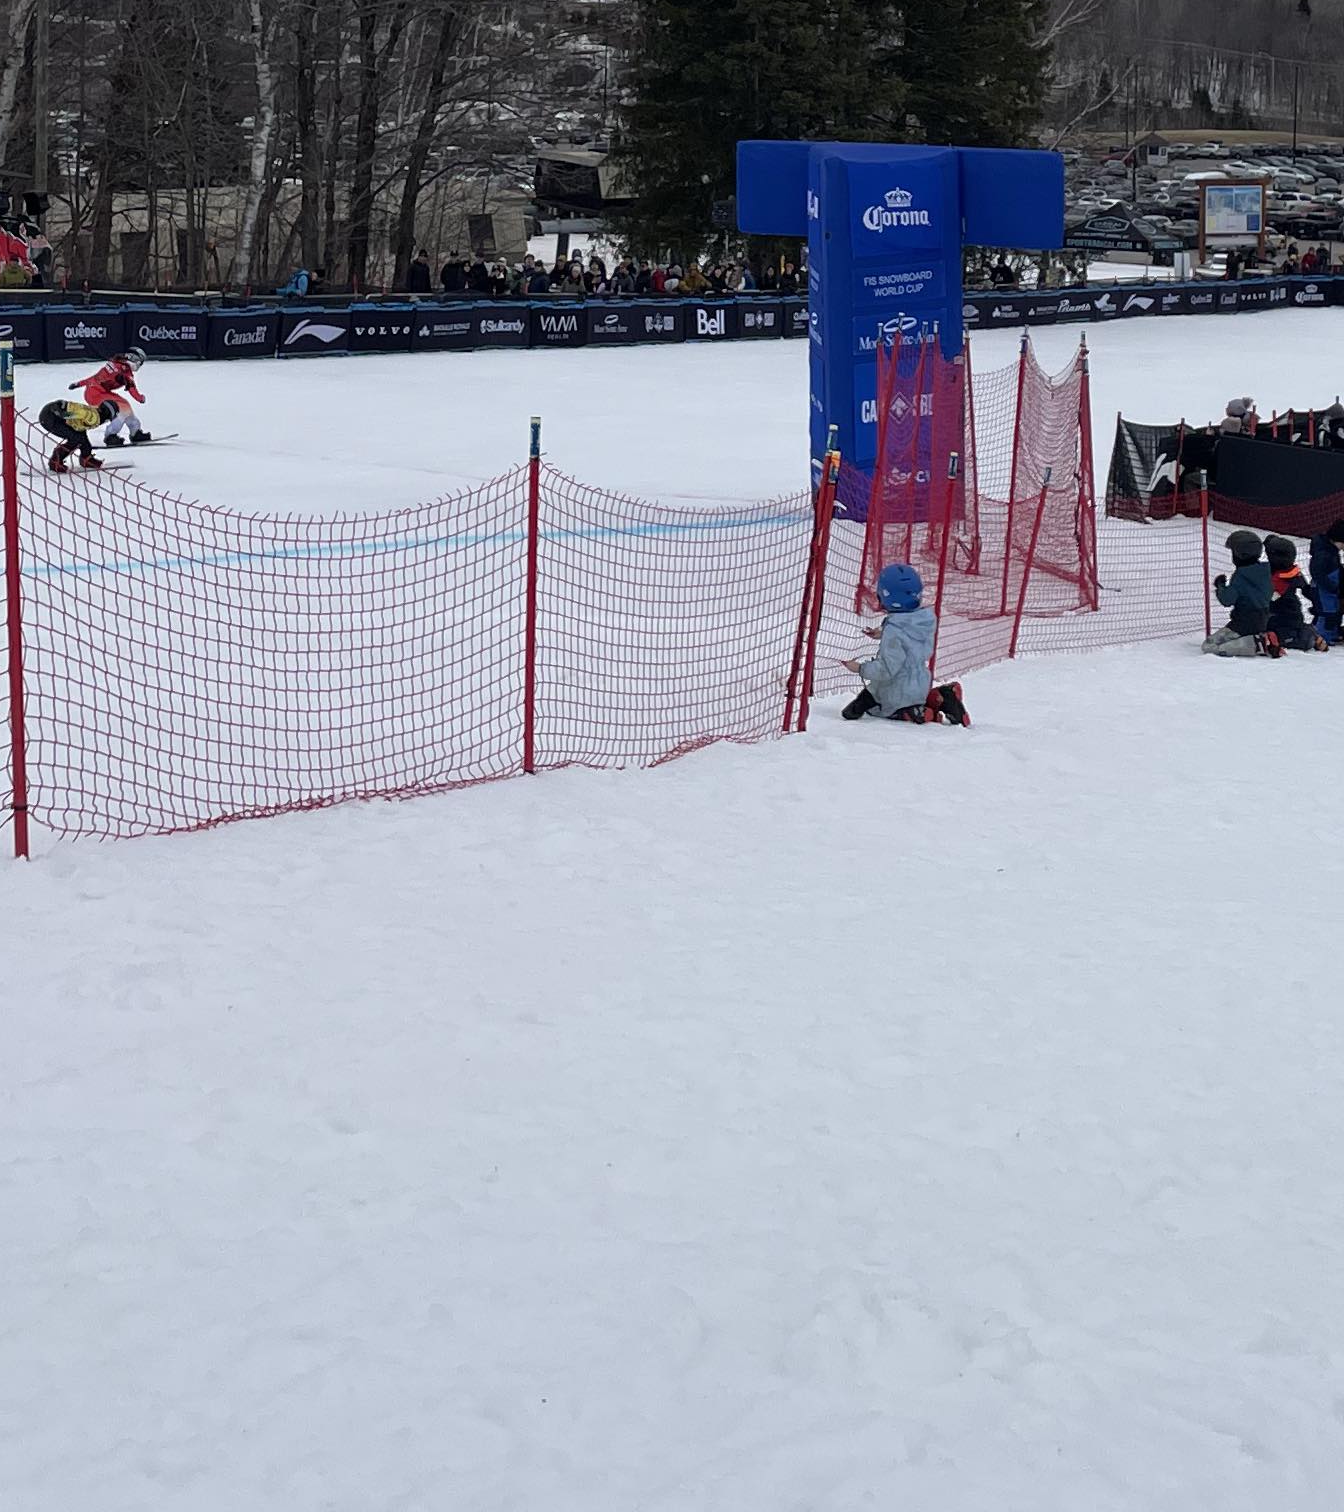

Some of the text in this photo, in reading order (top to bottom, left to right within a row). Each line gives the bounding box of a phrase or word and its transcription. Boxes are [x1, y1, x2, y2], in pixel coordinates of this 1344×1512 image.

[863, 206, 930, 233] Corona
[864, 270, 933, 287] FIS SNOWBOARD
[873, 283, 924, 297] WORLD CUP
[696, 308, 726, 335] Bell
[138, 324, 181, 342] Québec
[223, 325, 267, 346] Canada
[355, 325, 411, 337] VOLVO
